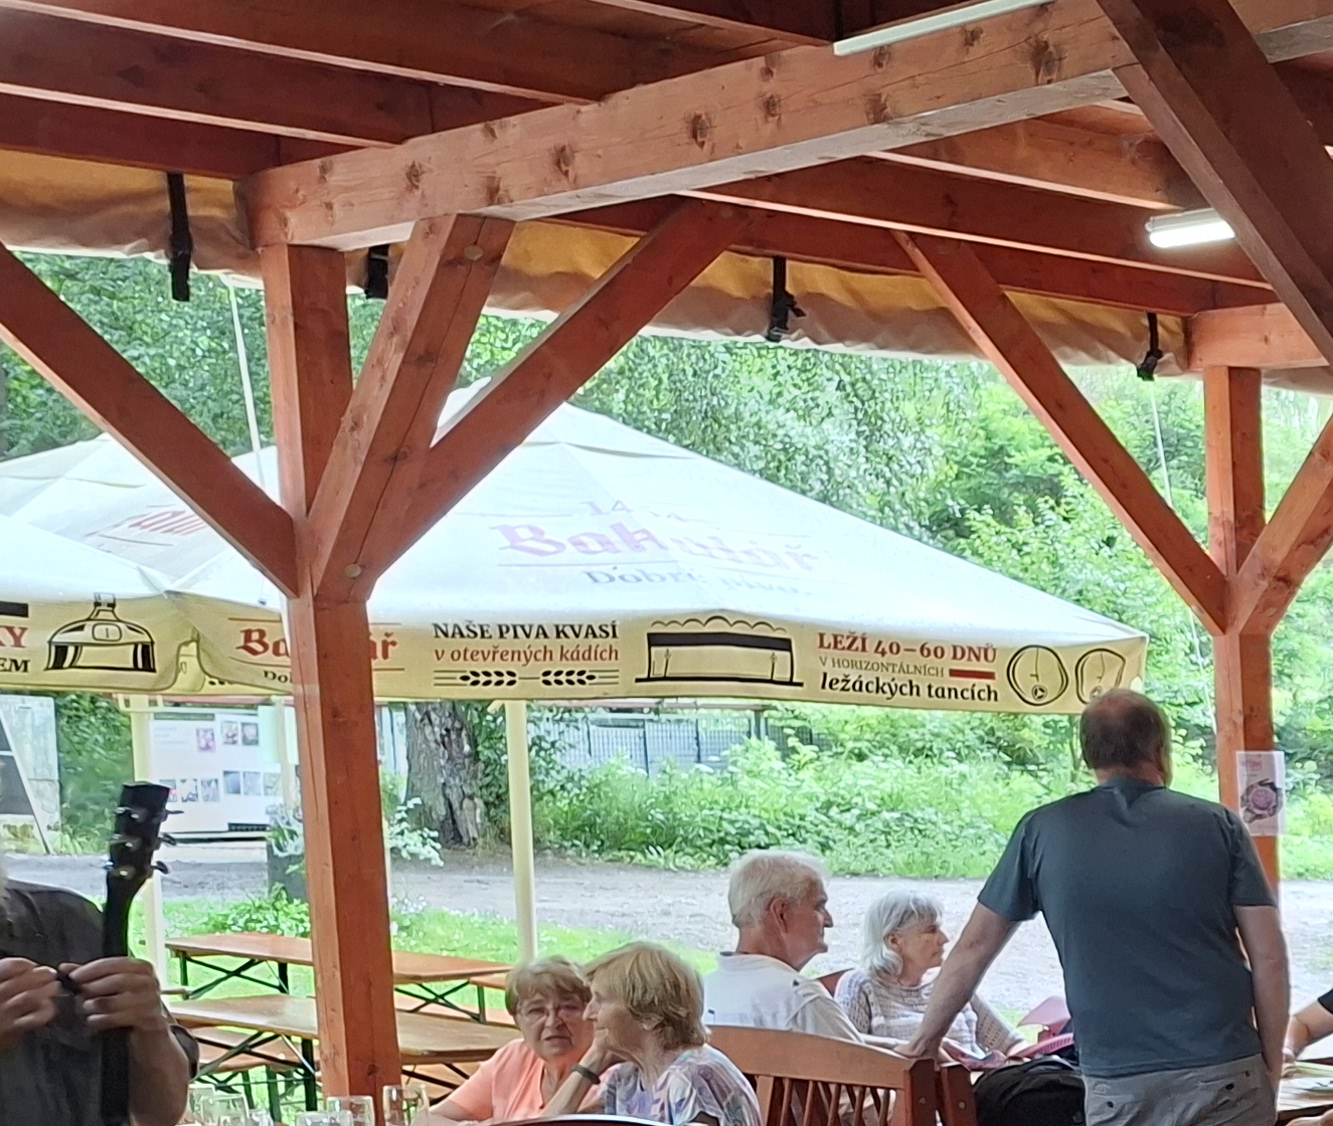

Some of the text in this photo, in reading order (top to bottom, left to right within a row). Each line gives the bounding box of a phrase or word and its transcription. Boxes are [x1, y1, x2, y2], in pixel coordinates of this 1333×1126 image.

[432, 619, 619, 639] NAŠE PIVA KVASÍ
[434, 644, 619, 667] v otevřených kádích
[817, 631, 868, 653] LEŽÍ
[951, 642, 997, 663] DNŮ
[819, 656, 945, 678] V HORIZONTÁLNÍCH
[821, 671, 999, 702] ležáckých tancích
